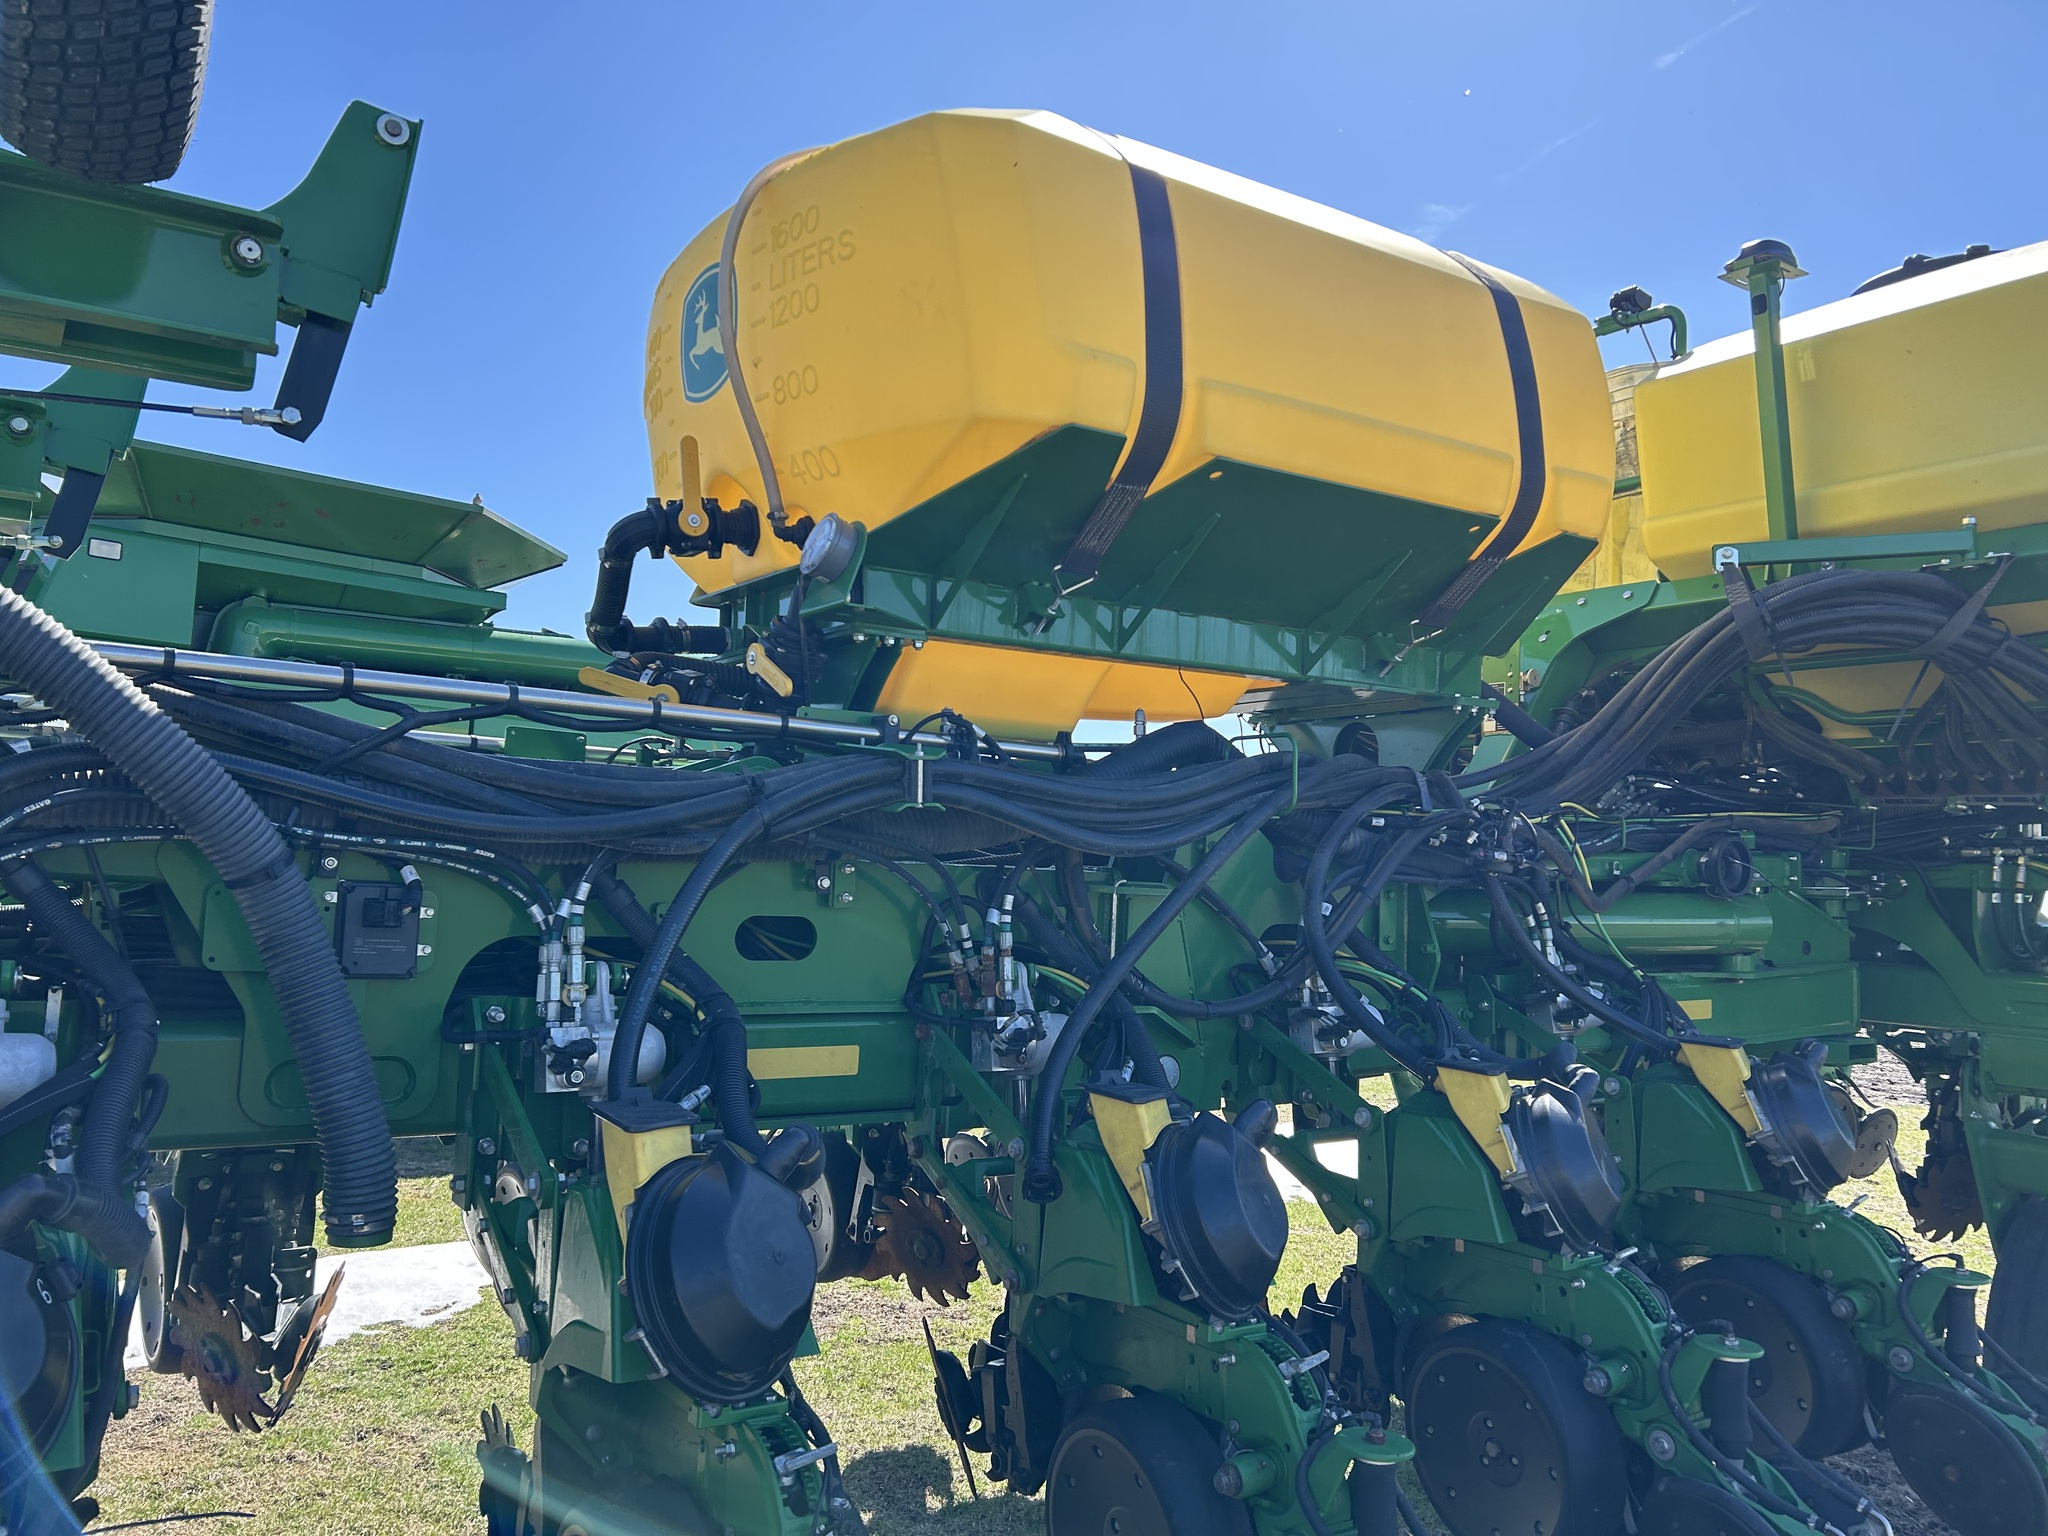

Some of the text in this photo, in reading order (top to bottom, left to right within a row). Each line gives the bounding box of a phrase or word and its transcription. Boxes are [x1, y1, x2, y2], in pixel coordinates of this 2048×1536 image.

[771, 204, 820, 253] 1600
[769, 228, 857, 291] LITERS
[770, 282, 819, 329] 1200
[772, 364, 819, 405] 800
[790, 445, 841, 484] 400
[36, 1278, 53, 1304] 6
